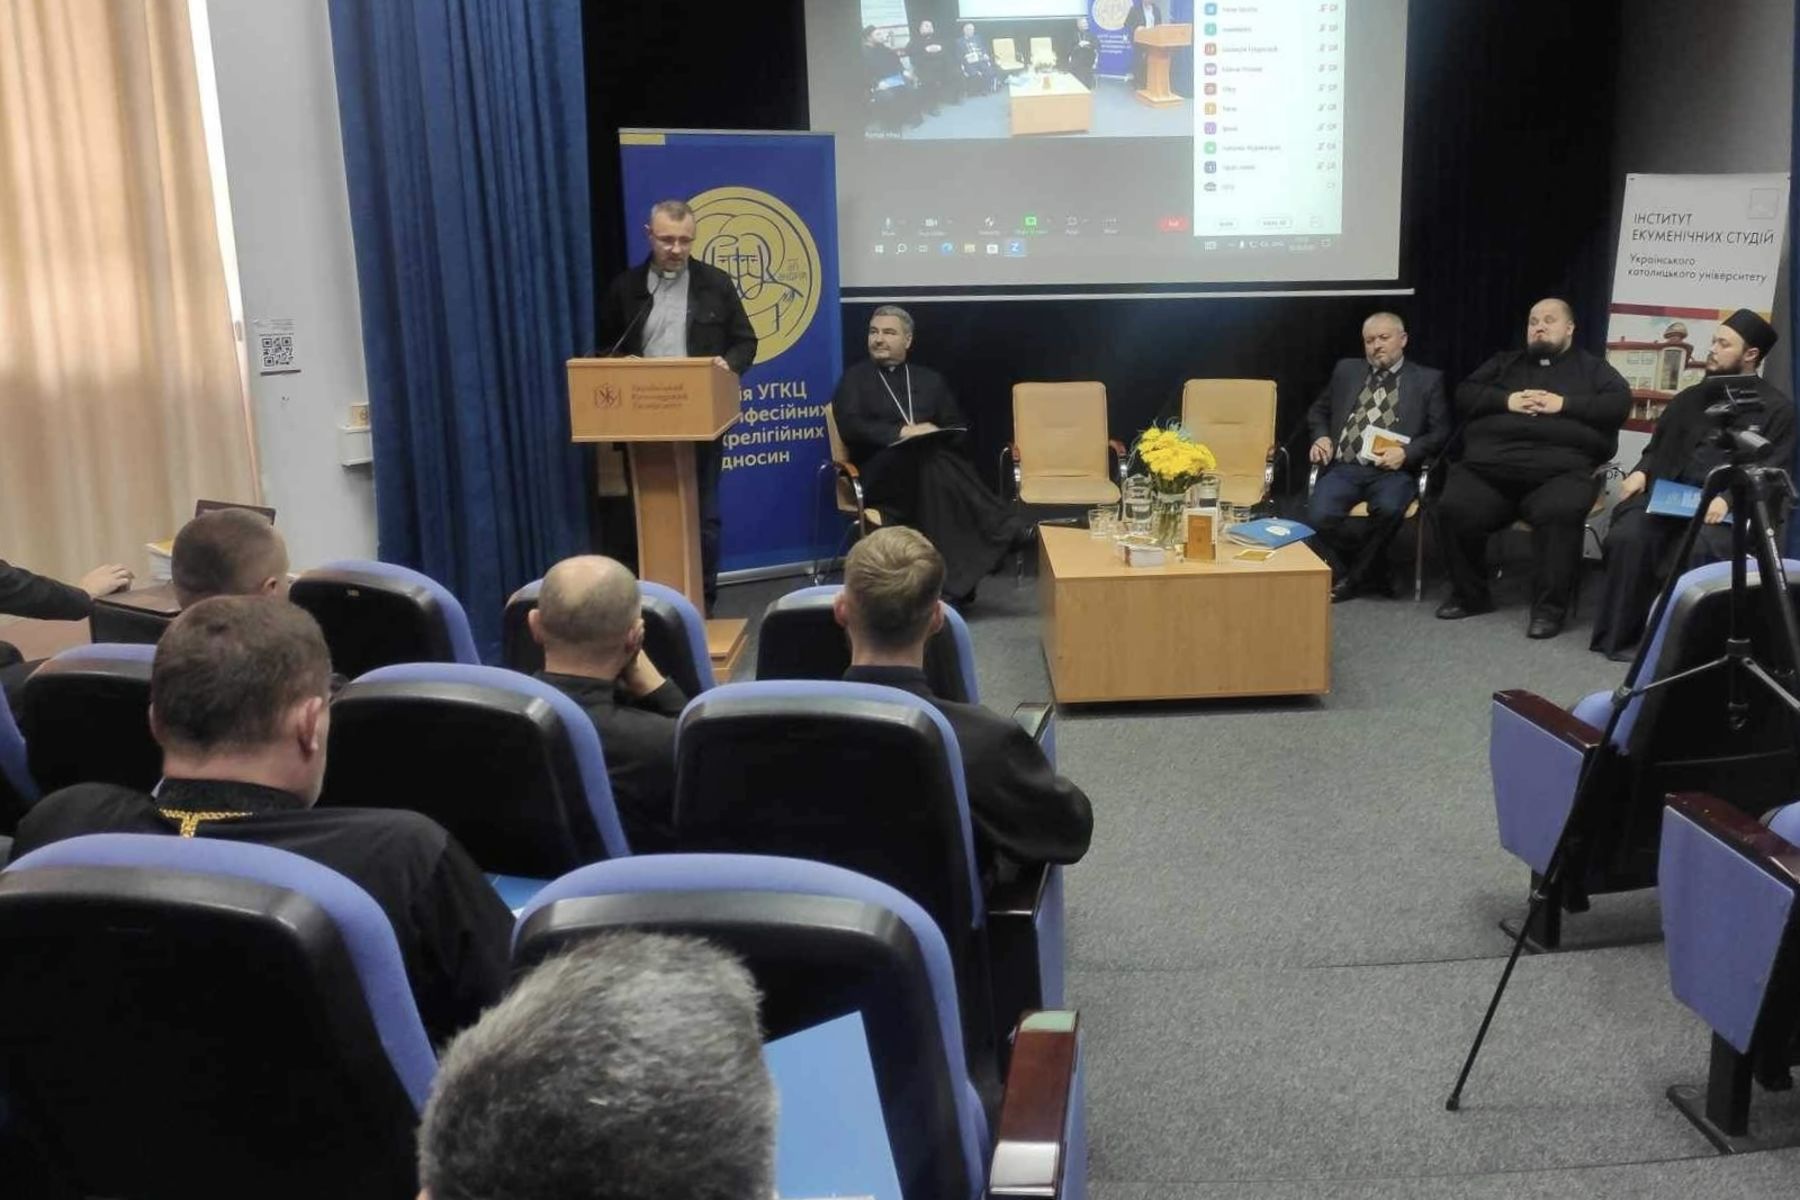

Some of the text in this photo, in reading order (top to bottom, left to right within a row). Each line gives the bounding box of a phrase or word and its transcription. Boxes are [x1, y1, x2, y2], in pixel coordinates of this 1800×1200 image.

[1634, 212, 1693, 224] ІНСТИТУТ
[1632, 228, 1775, 246] ЕКУМЕНІЧНИХ СТУДІЙ
[1629, 253, 1695, 266] Українського
[1627, 269, 1768, 286] католицького університету
[757, 381, 807, 400] УГКЦ
[740, 404, 827, 426] фесійних
[721, 450, 790, 471] дносин
